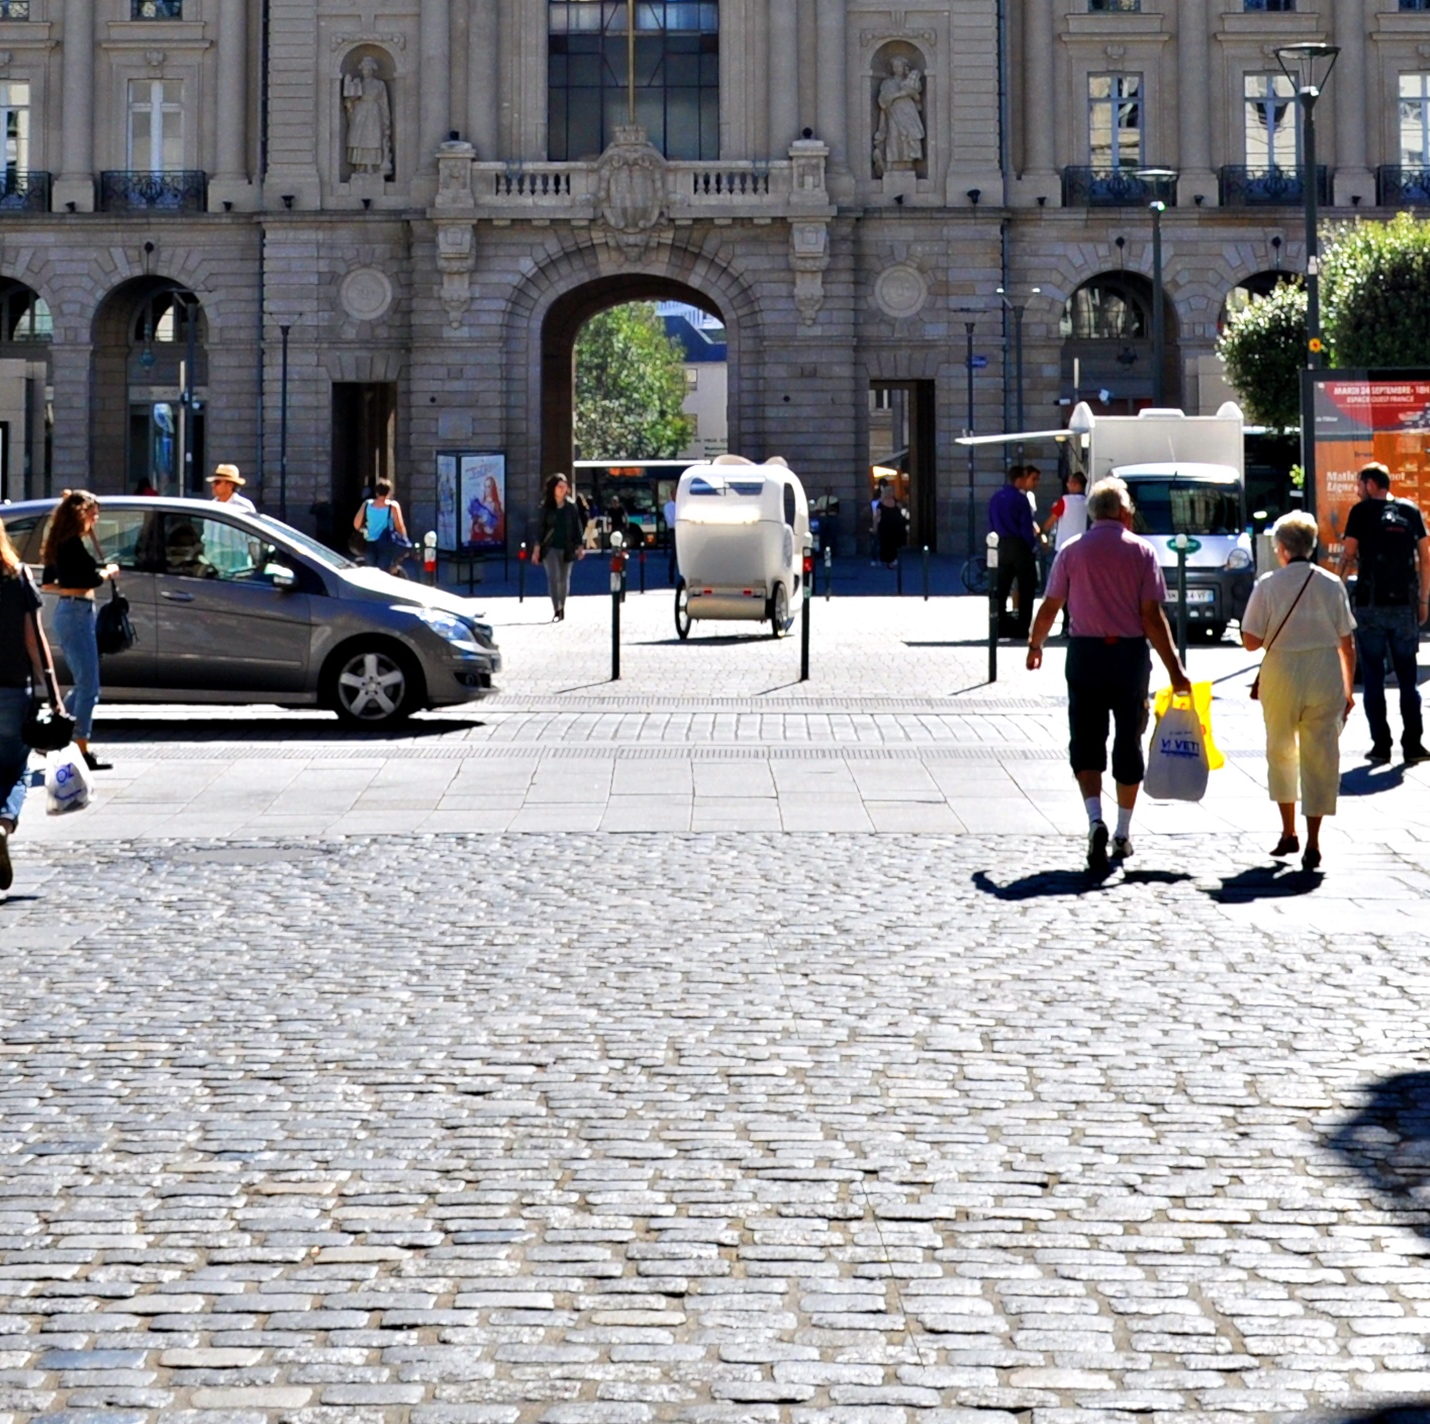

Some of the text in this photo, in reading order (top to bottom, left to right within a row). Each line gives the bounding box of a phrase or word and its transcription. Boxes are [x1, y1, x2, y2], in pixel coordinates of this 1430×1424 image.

[1334, 386, 1360, 395] MARDI
[1347, 395, 1414, 403] ESPACE OUEST FRANCE
